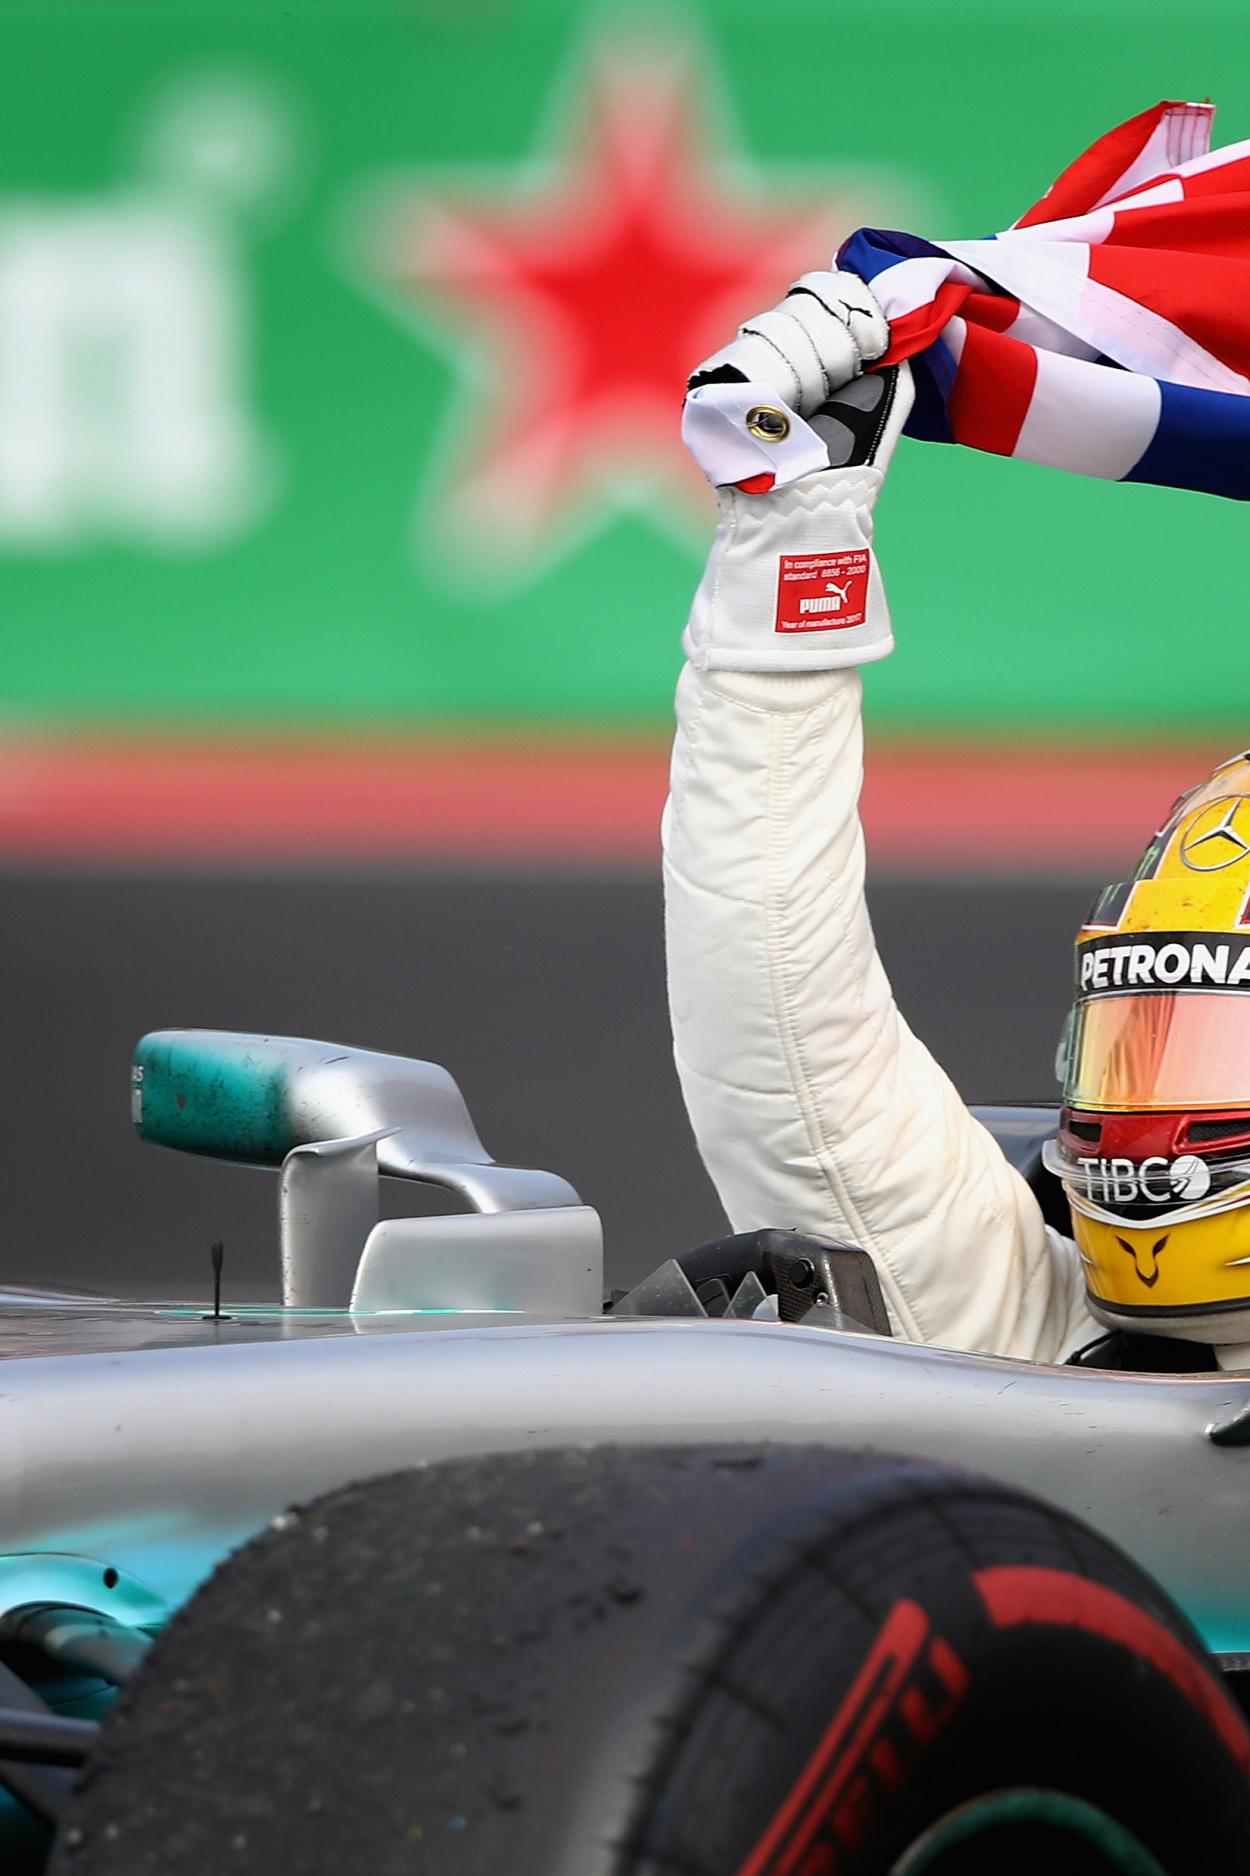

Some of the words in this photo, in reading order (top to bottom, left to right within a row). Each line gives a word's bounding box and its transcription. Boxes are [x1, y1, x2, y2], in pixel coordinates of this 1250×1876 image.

[784, 560, 793, 570] In
[794, 557, 836, 569] compliance
[838, 556, 852, 566] with
[853, 554, 868, 564] FIA
[783, 571, 817, 581] standard
[799, 596, 841, 614] PUMA
[781, 619, 798, 630] Year
[798, 619, 806, 629] of
[806, 617, 846, 628] manufacture
